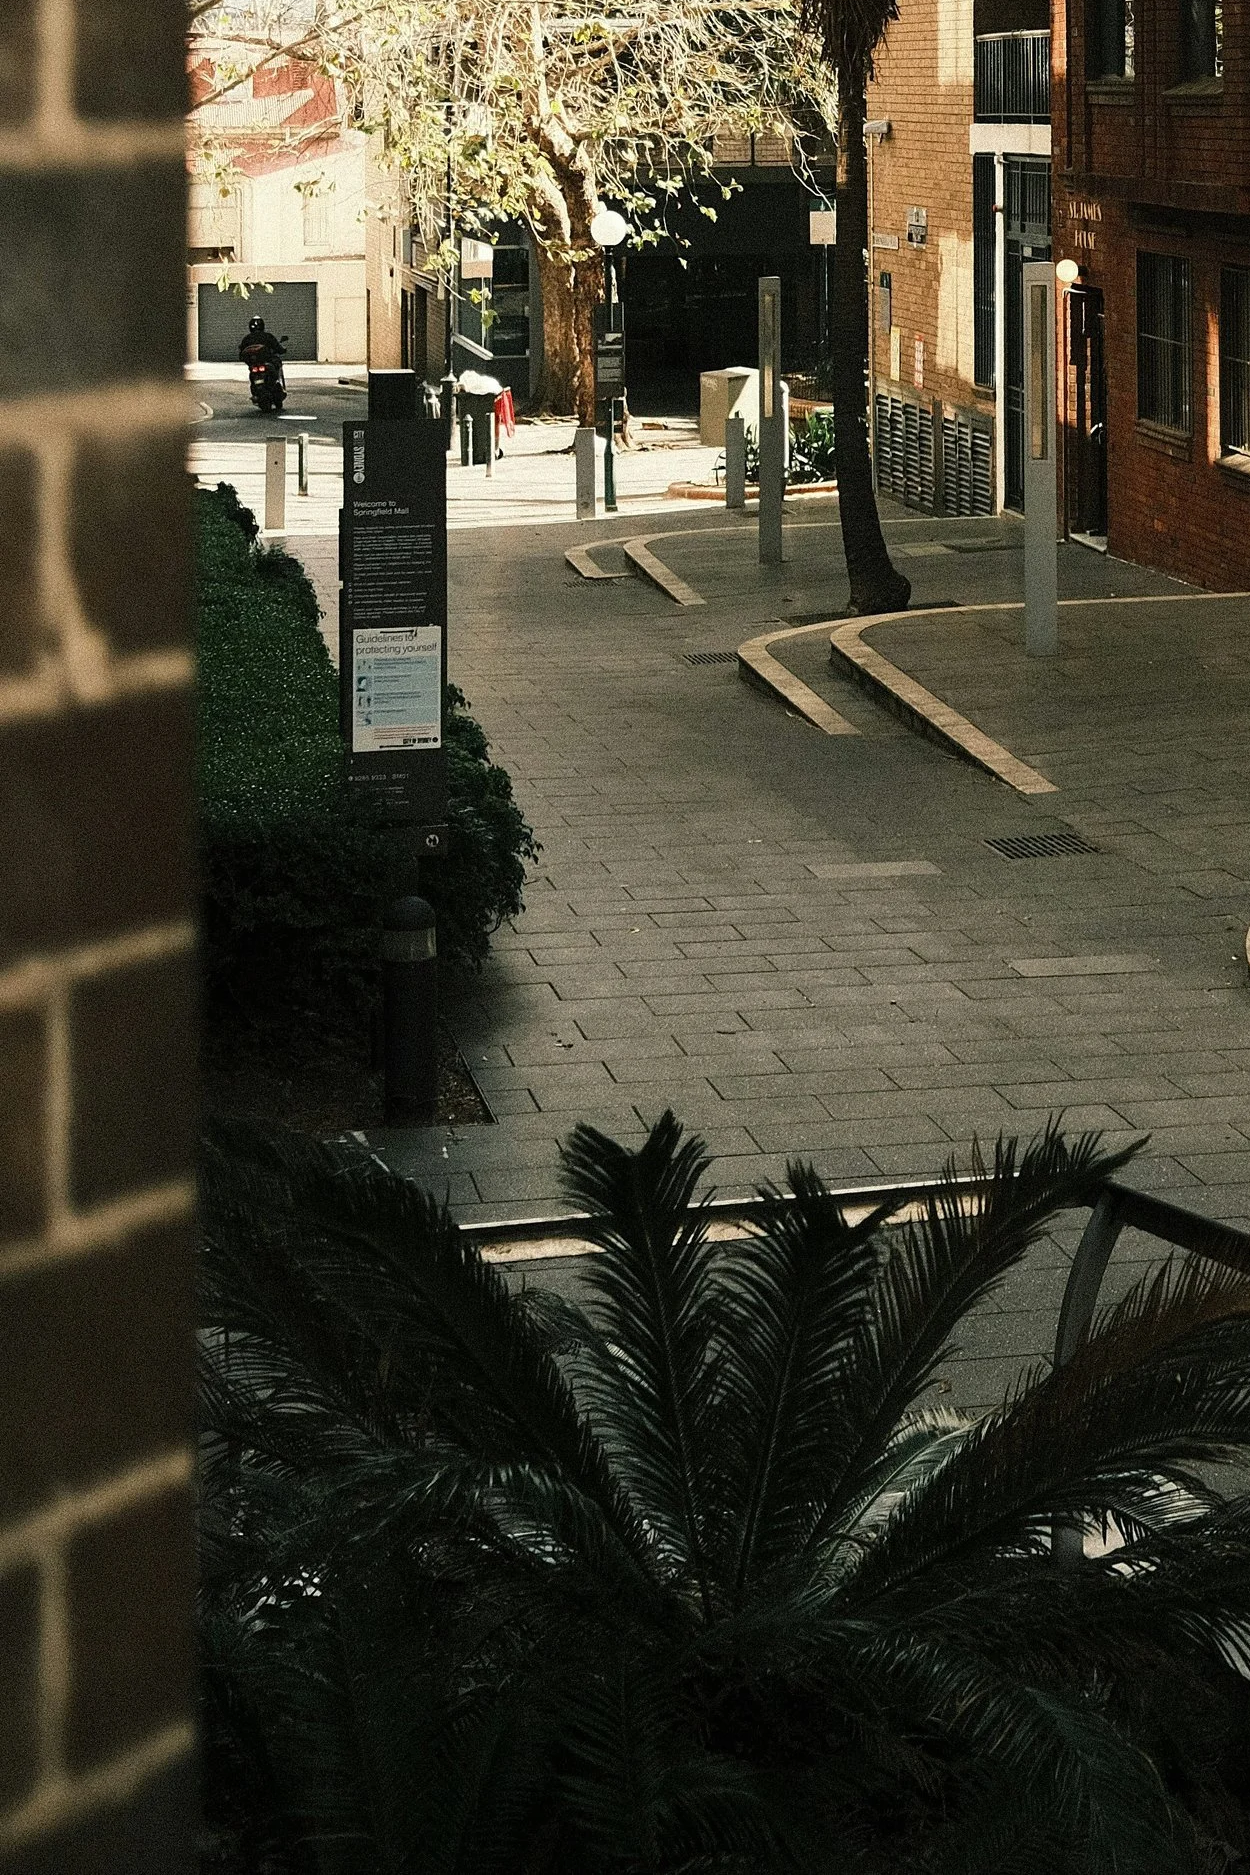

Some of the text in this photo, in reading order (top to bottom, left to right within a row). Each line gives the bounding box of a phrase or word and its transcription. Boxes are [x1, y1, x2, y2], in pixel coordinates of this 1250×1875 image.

[1080, 202, 1102, 221] JAMES
[1074, 229, 1096, 249] HOUSE
[353, 446, 365, 473] SYDNEY
[353, 507, 409, 517] Springfield Mall
[356, 633, 414, 644] Guidelines to
[356, 643, 437, 656] protecting yourself
